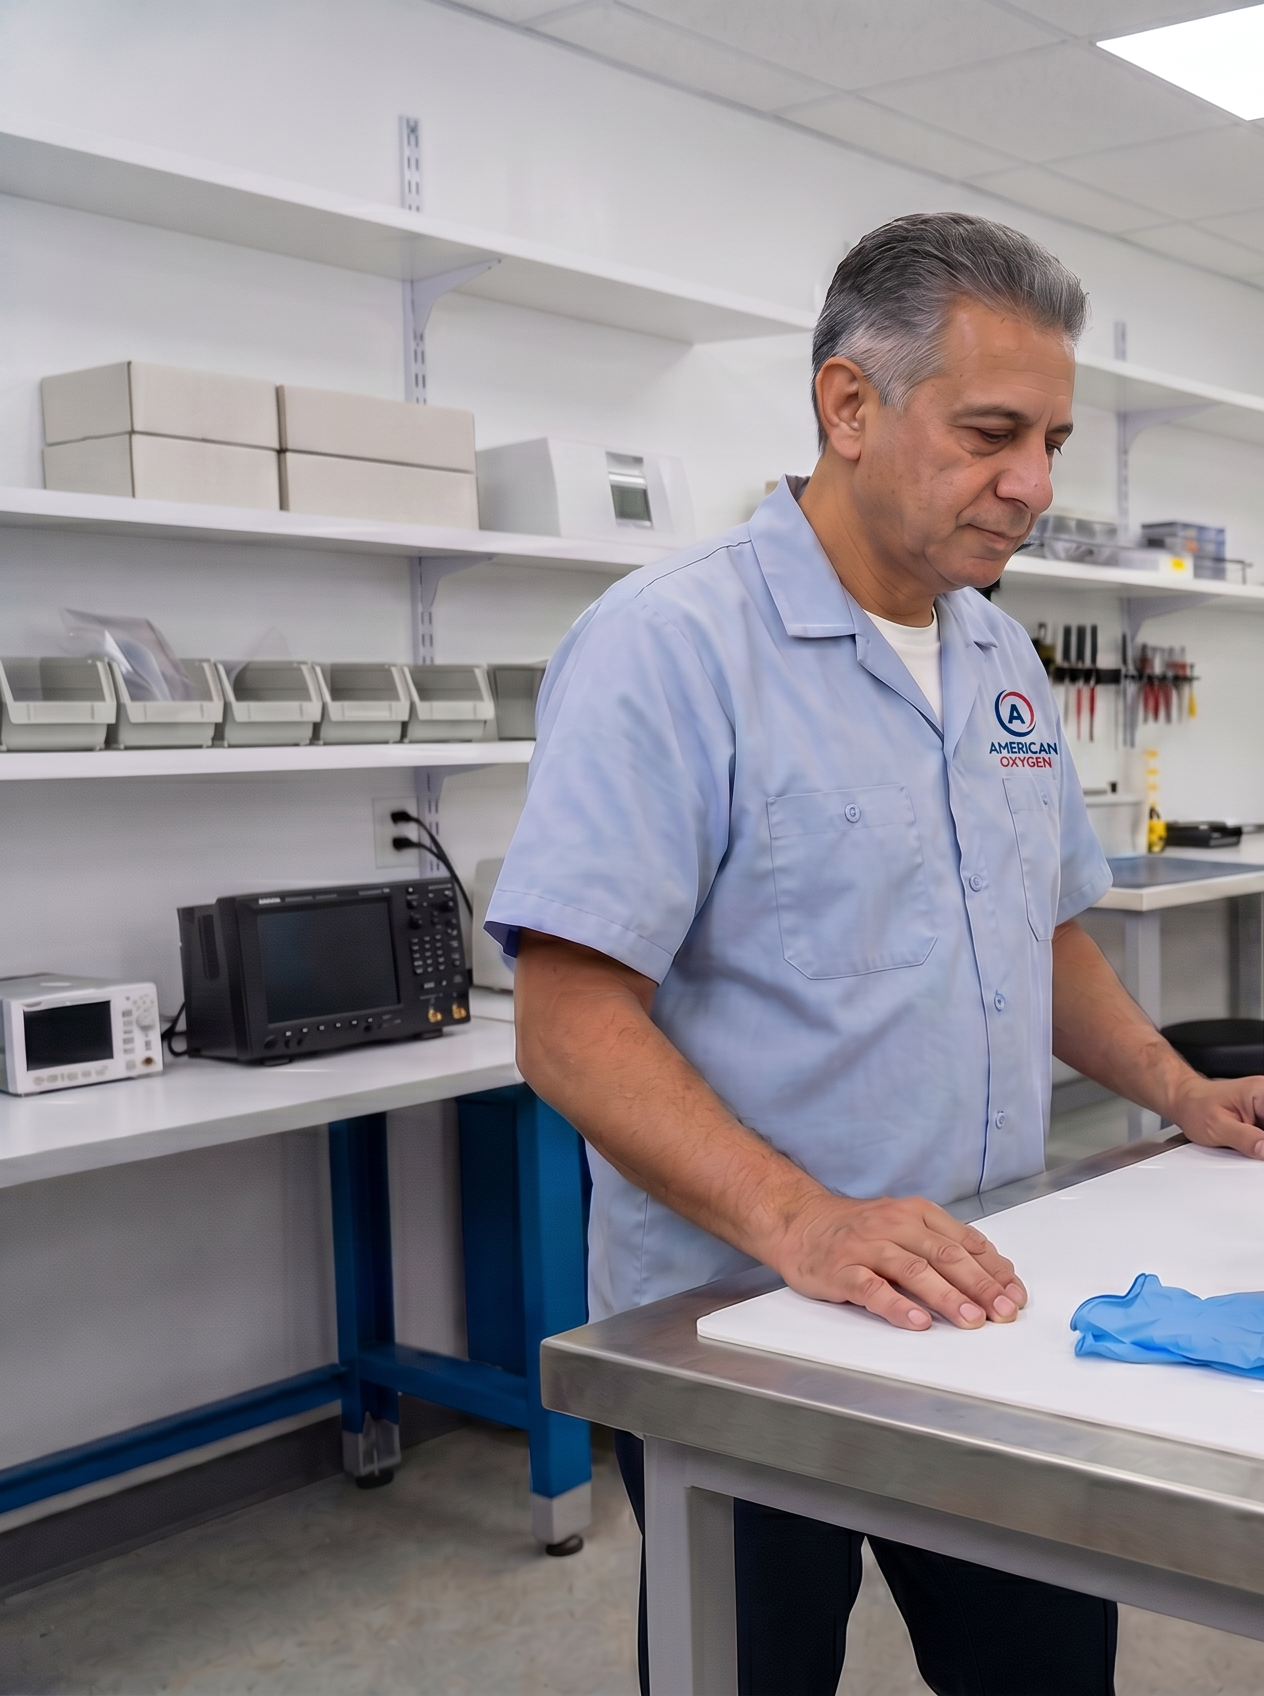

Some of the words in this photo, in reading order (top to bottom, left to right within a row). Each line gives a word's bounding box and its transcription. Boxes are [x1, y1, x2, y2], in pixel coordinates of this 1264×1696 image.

[1007, 703, 1026, 725] A
[989, 741, 1059, 756] AMERICAN
[999, 755, 1053, 769] OXYGEN
